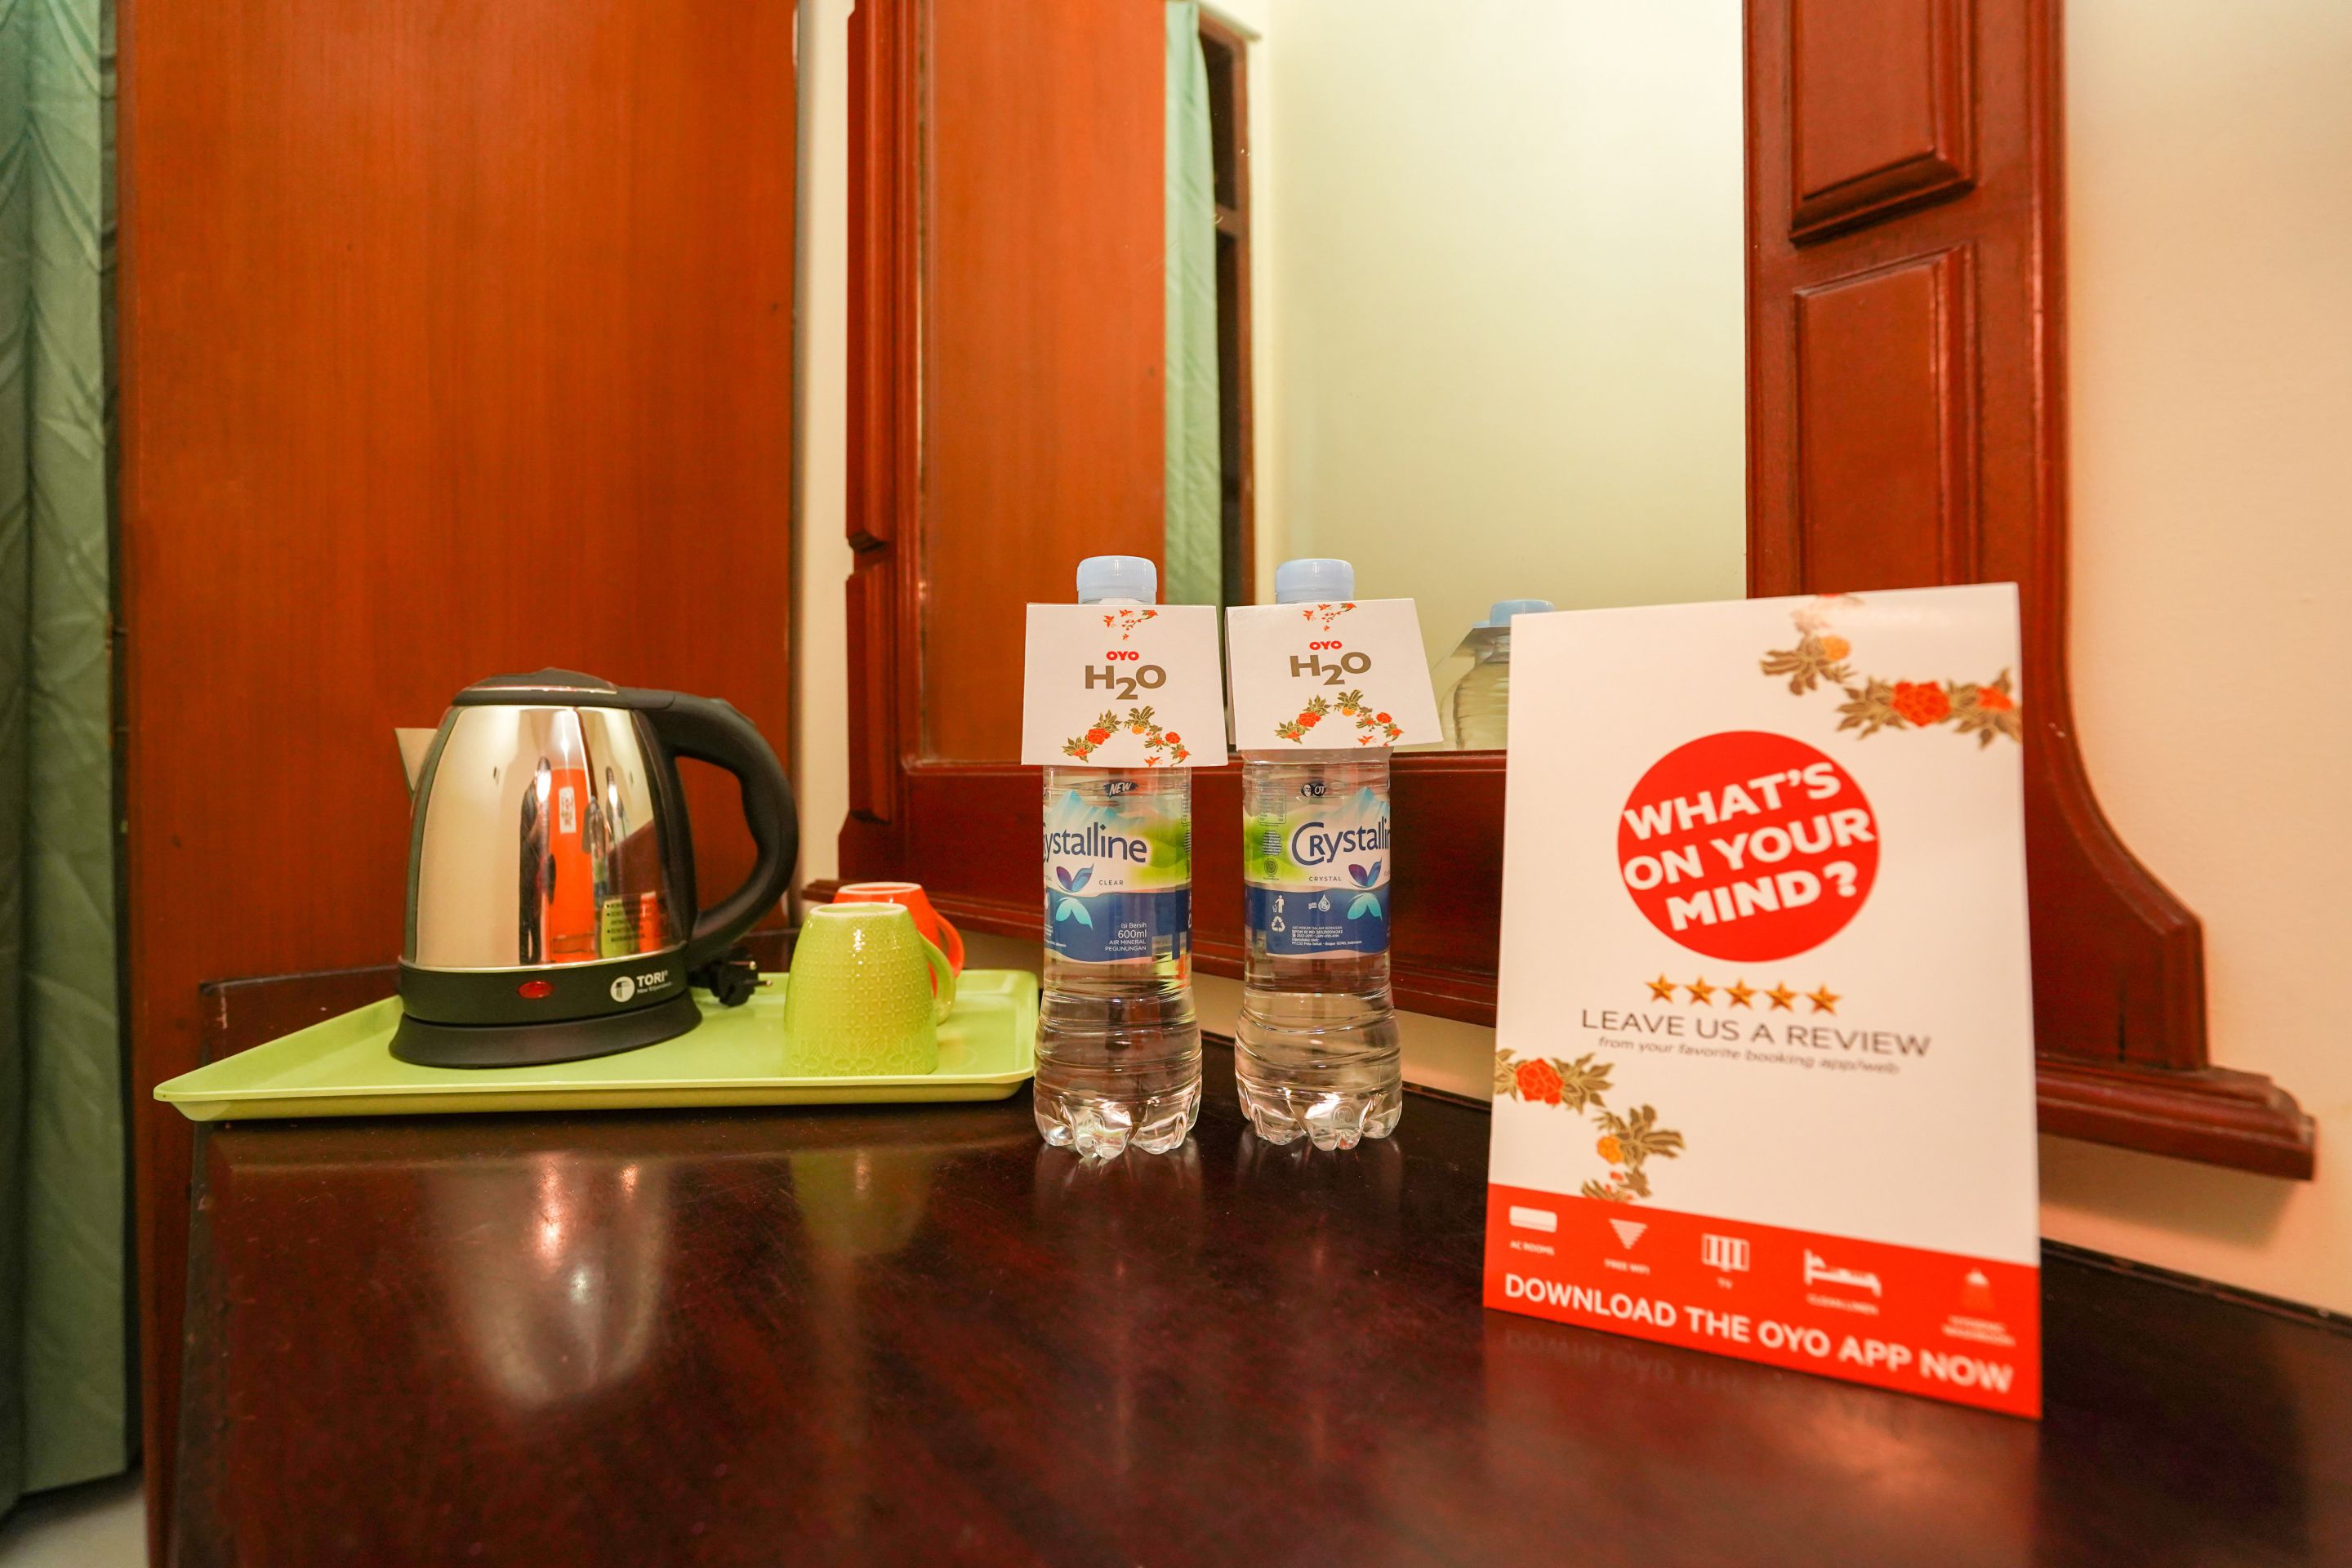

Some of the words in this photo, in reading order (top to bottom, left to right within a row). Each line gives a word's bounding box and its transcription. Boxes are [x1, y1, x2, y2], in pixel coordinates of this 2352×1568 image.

[1106, 651, 1139, 661] OYO
[1308, 640, 1343, 650] OYO
[1085, 664, 1166, 700] H2O
[1290, 652, 1372, 686] H2O
[1109, 781, 1133, 796] NEW
[1624, 762, 1842, 840] WHAT'S
[1624, 844, 1704, 890] ON
[1711, 808, 1876, 871] YOUR
[1117, 929, 1147, 938] 600ml
[636, 971, 666, 987] TORI
[1582, 1009, 1686, 1036] LEAVE
[1696, 1018, 1740, 1041] US
[1750, 1023, 1775, 1045] A
[1786, 1025, 1932, 1058] REVIEW
[1598, 1036, 1634, 1049] from
[1637, 1040, 1673, 1054] your
[1678, 1043, 1741, 1062] favorite
[1745, 1049, 1815, 1069] booking
[1504, 1272, 1677, 1327] DOWNLOAD
[1683, 1304, 1752, 1344] THE
[1757, 1319, 1831, 1358] OYO
[1838, 1334, 1913, 1372] APP
[1920, 1348, 2015, 1394] NOW
